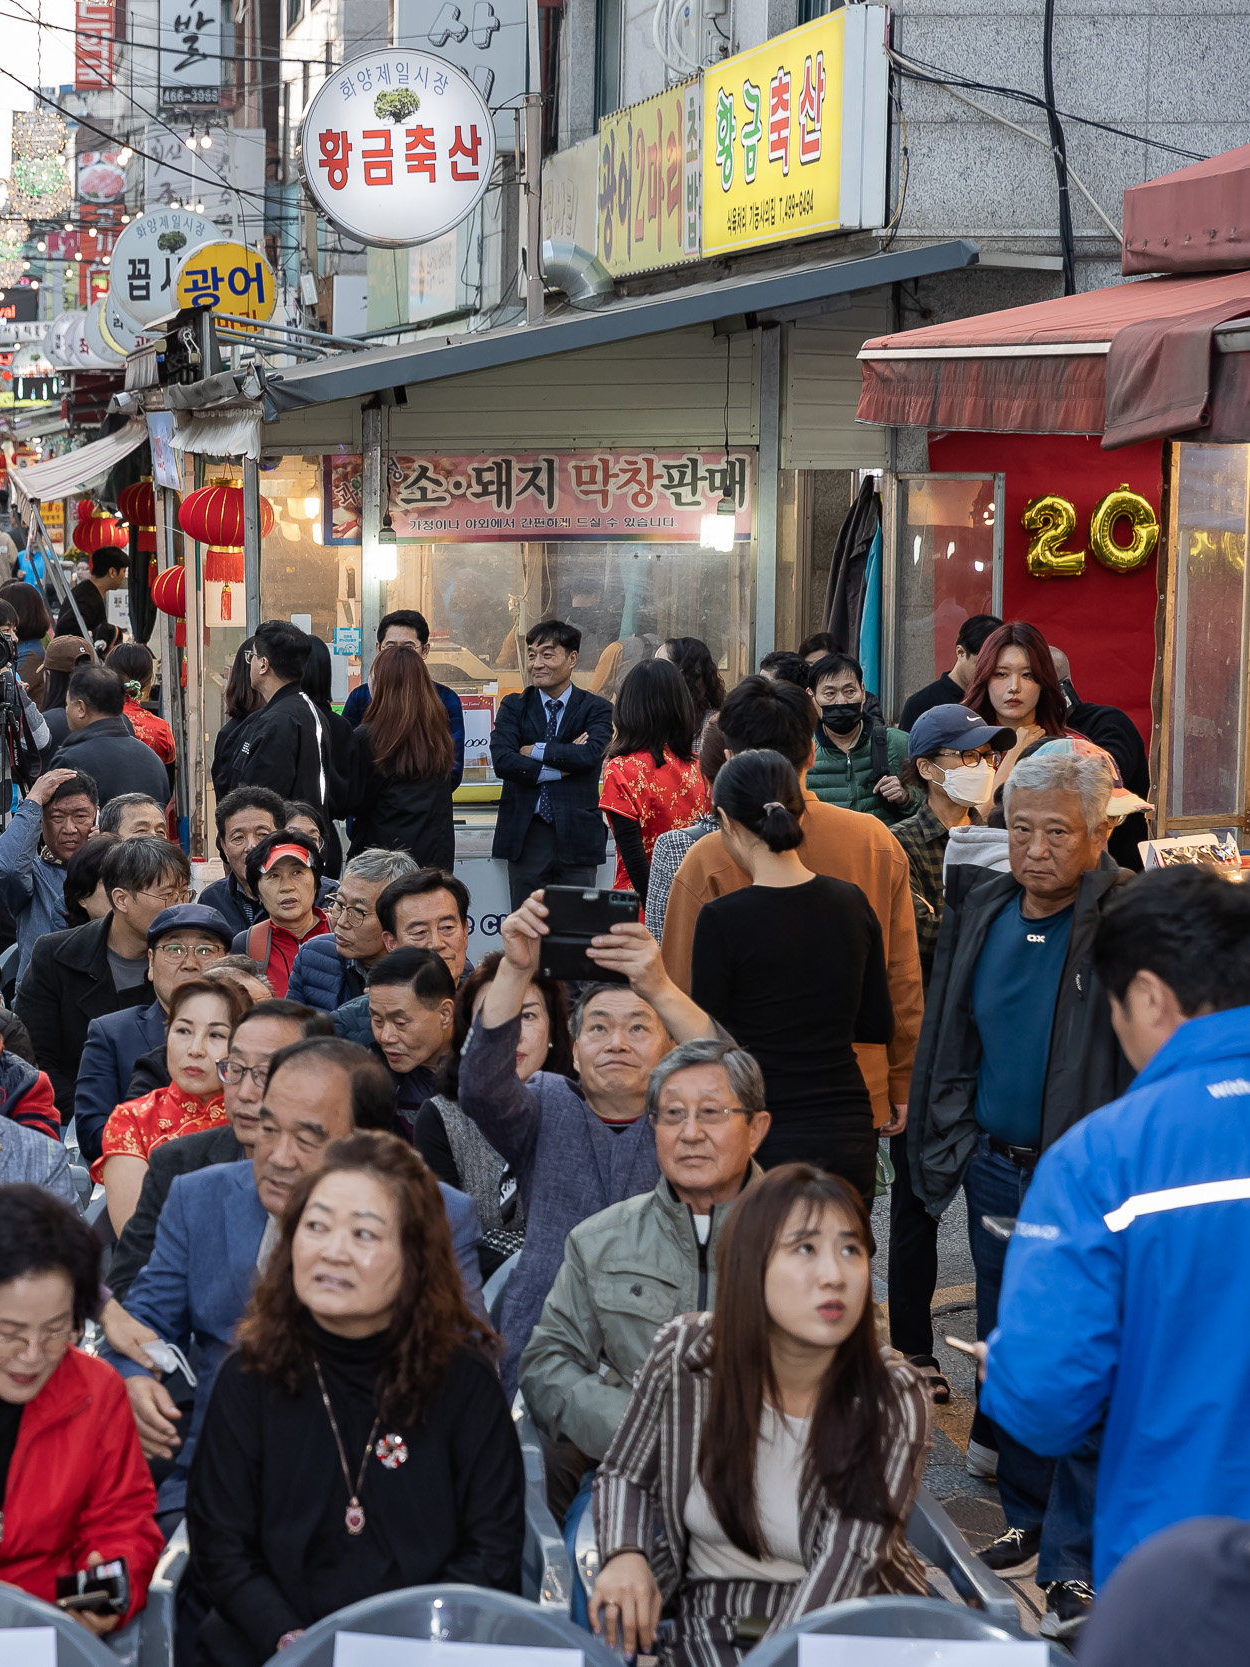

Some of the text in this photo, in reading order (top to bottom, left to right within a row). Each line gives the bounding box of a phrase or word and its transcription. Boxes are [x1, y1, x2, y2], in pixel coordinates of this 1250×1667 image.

[339, 62, 449, 101] 화양제일시장
[715, 50, 826, 193] 황금축산
[318, 124, 482, 190] 황금축산
[600, 99, 683, 263] 광어2마리
[136, 212, 206, 239] 화양제일시장
[184, 263, 264, 308] 광어
[571, 457, 747, 510] 막창판매
[409, 516, 678, 531] 가정이나 야외에서 간편하게 드실 수 있습니다.
